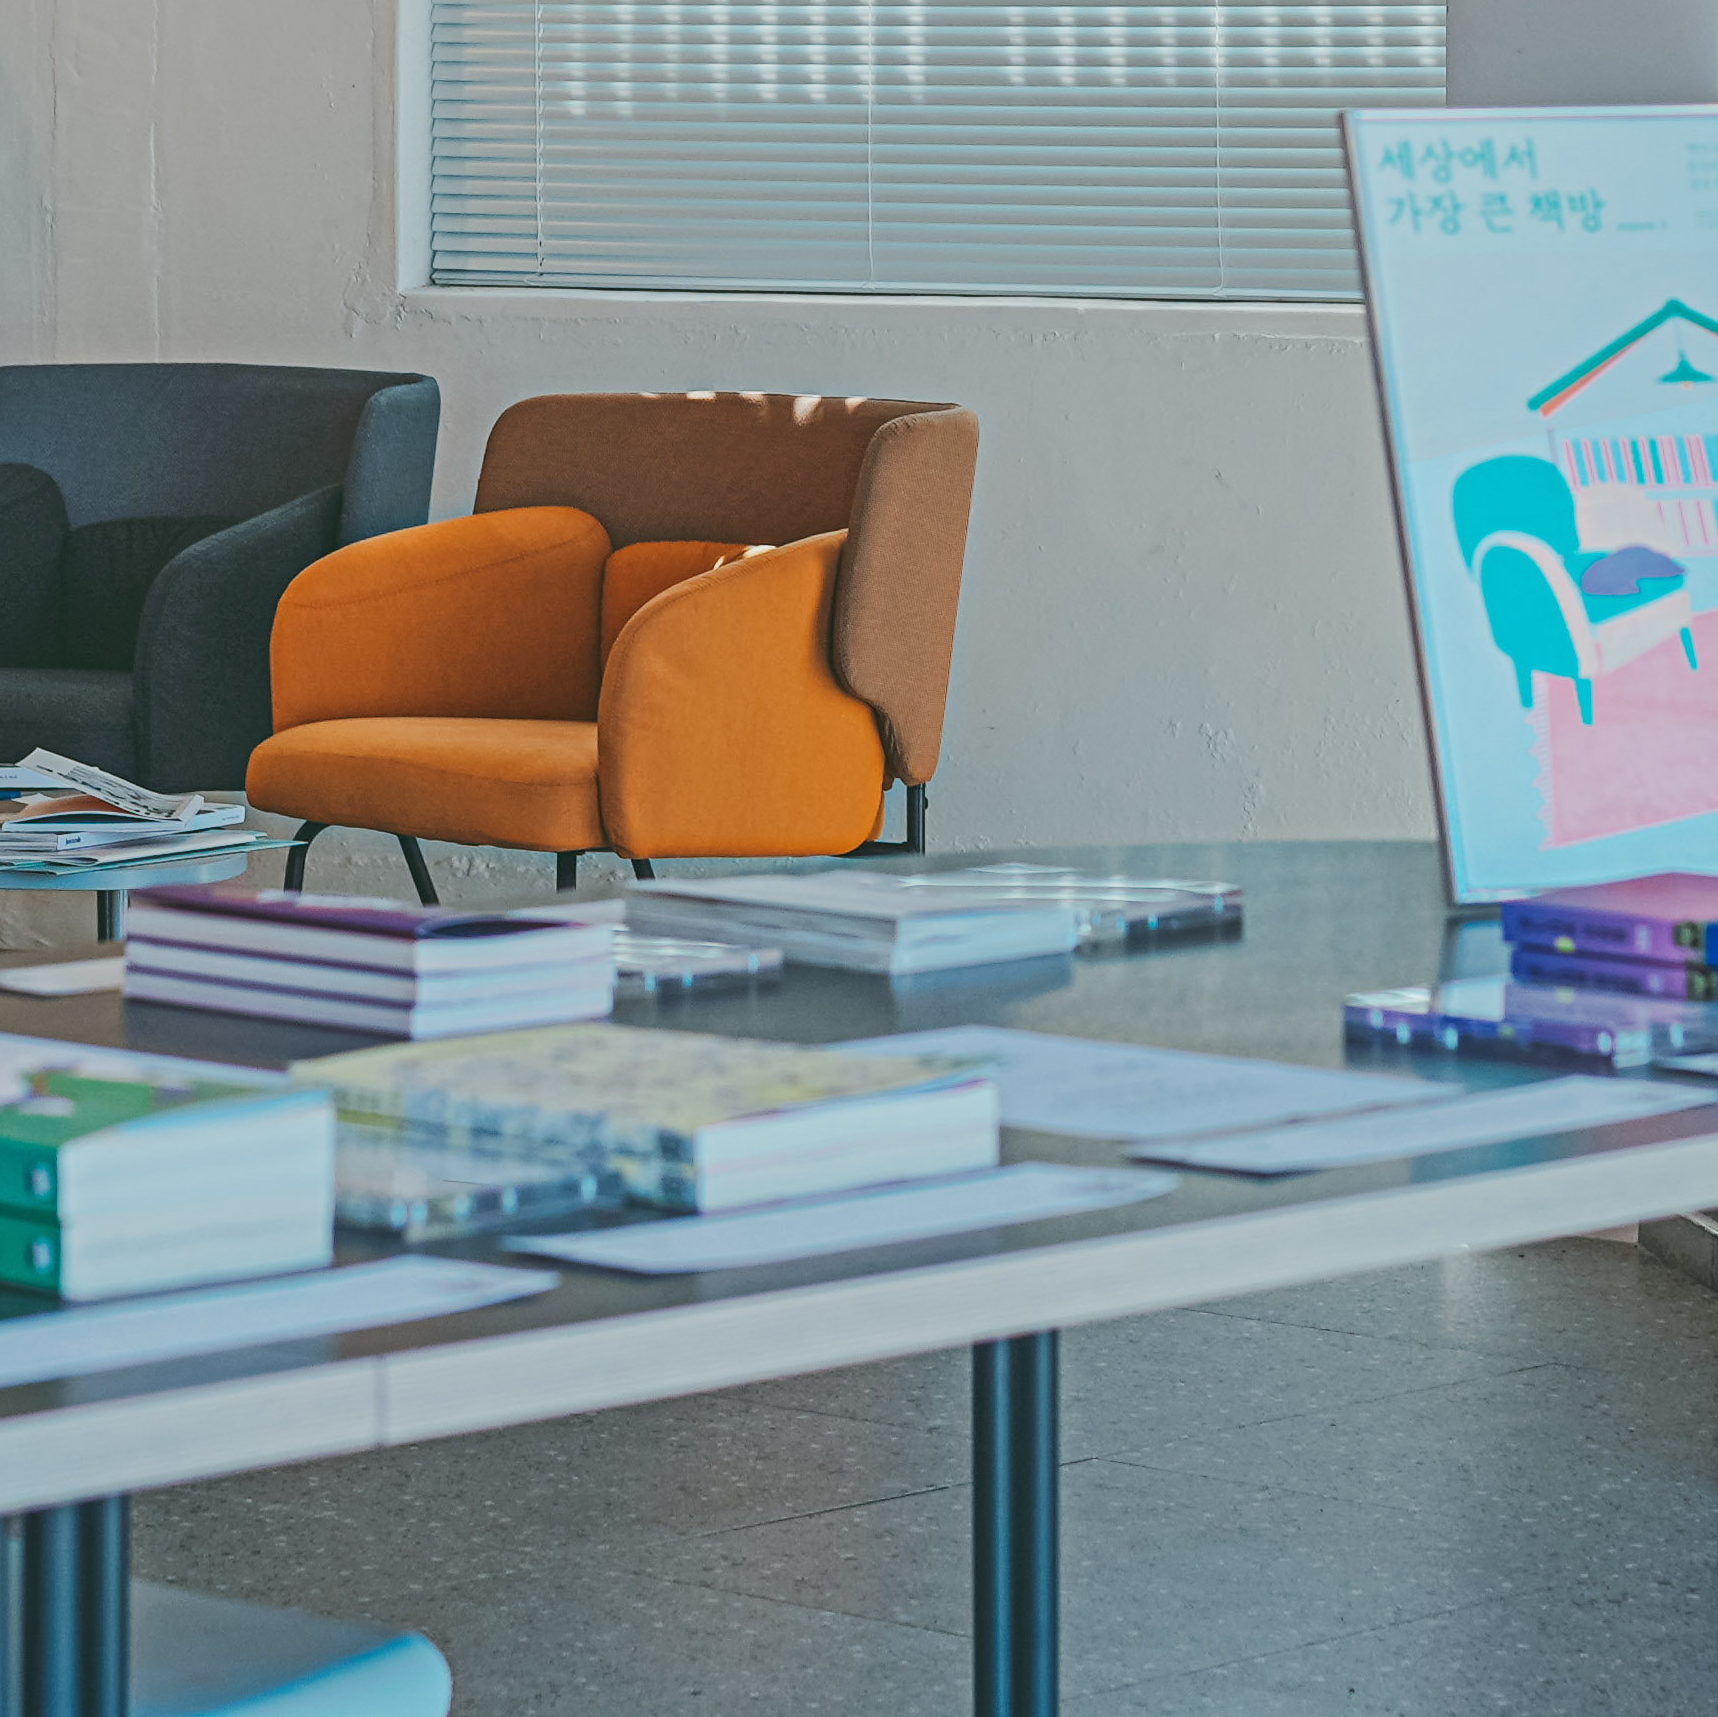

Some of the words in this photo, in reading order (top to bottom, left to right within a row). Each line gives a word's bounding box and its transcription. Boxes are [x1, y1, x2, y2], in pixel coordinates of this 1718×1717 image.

[1378, 138, 1538, 183] 세상에서
[1388, 190, 1463, 235] 가장
[1480, 191, 1515, 233] 큰
[1529, 186, 1606, 233] 책방
